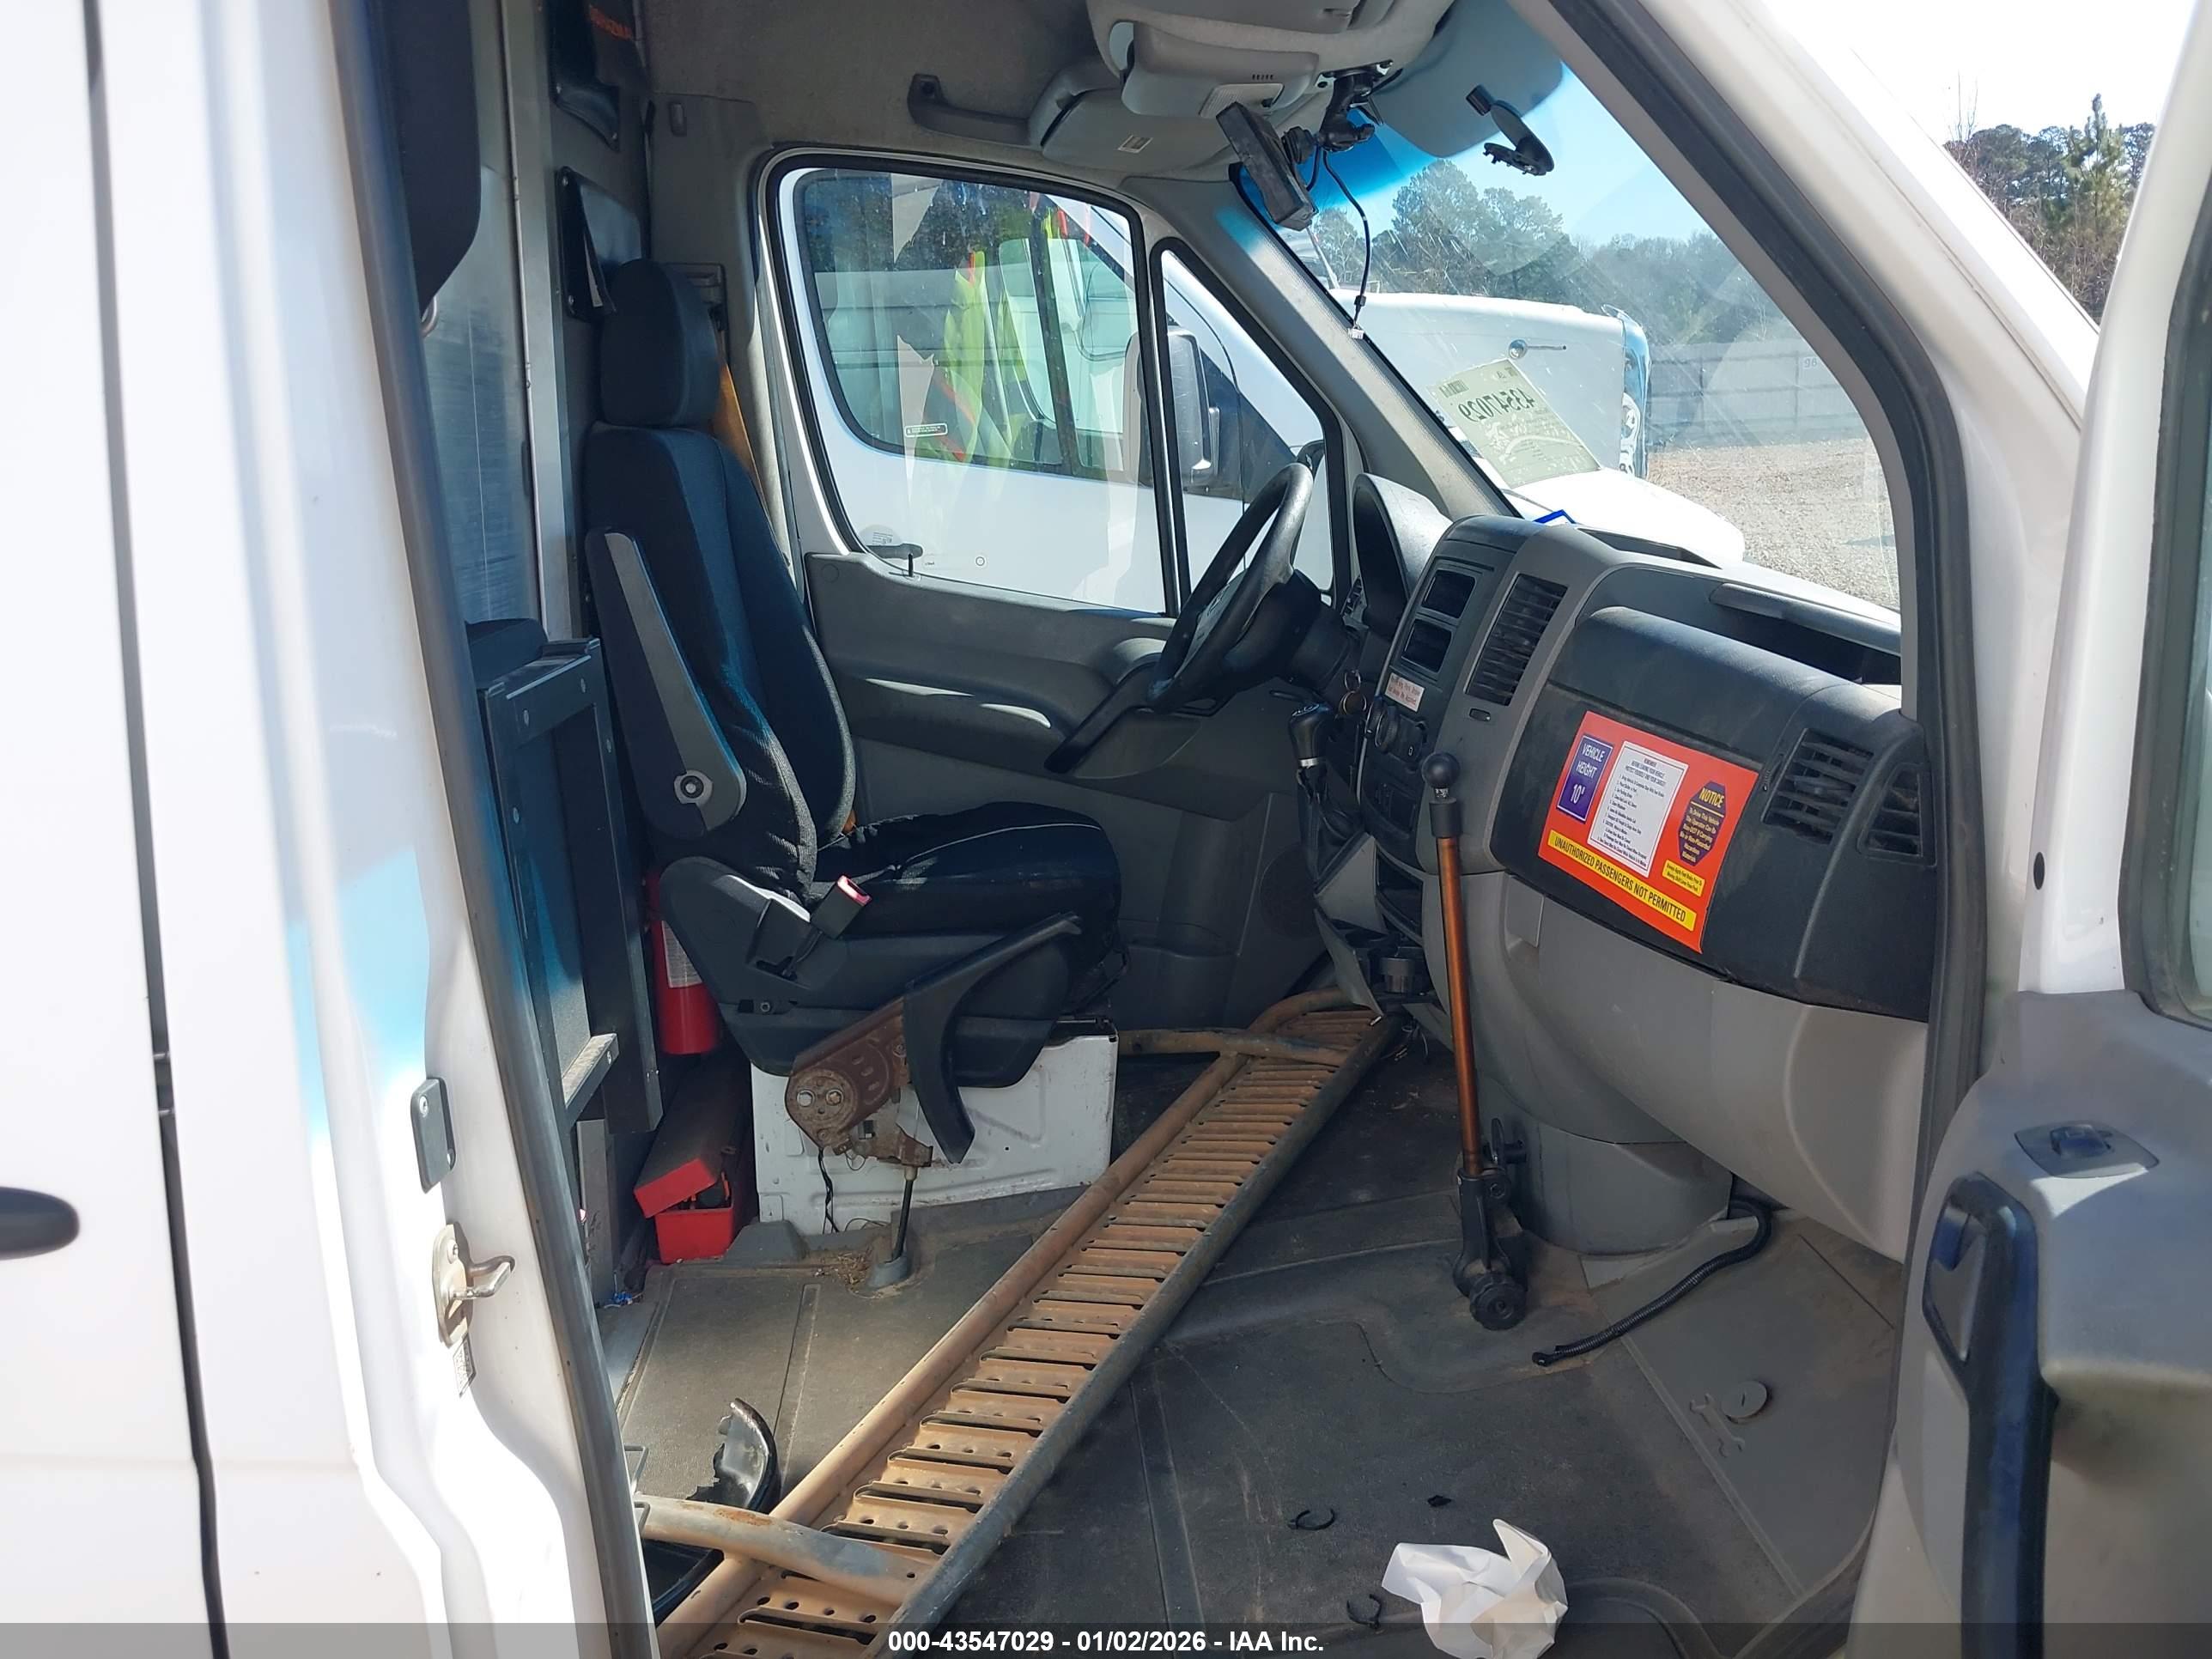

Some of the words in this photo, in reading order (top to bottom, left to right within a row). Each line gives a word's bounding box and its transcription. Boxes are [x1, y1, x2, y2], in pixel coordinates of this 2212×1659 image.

[1582, 743, 1606, 763] VEHICLE
[1576, 760, 1597, 779] HEIGHT
[1699, 787, 1724, 808] NOTICE
[1554, 836, 1595, 866] UNAUTHORIZED
[1595, 861, 1634, 890] PASSENGERS
[1634, 884, 1649, 900] NOT
[1648, 892, 1686, 922] PERMITTED
